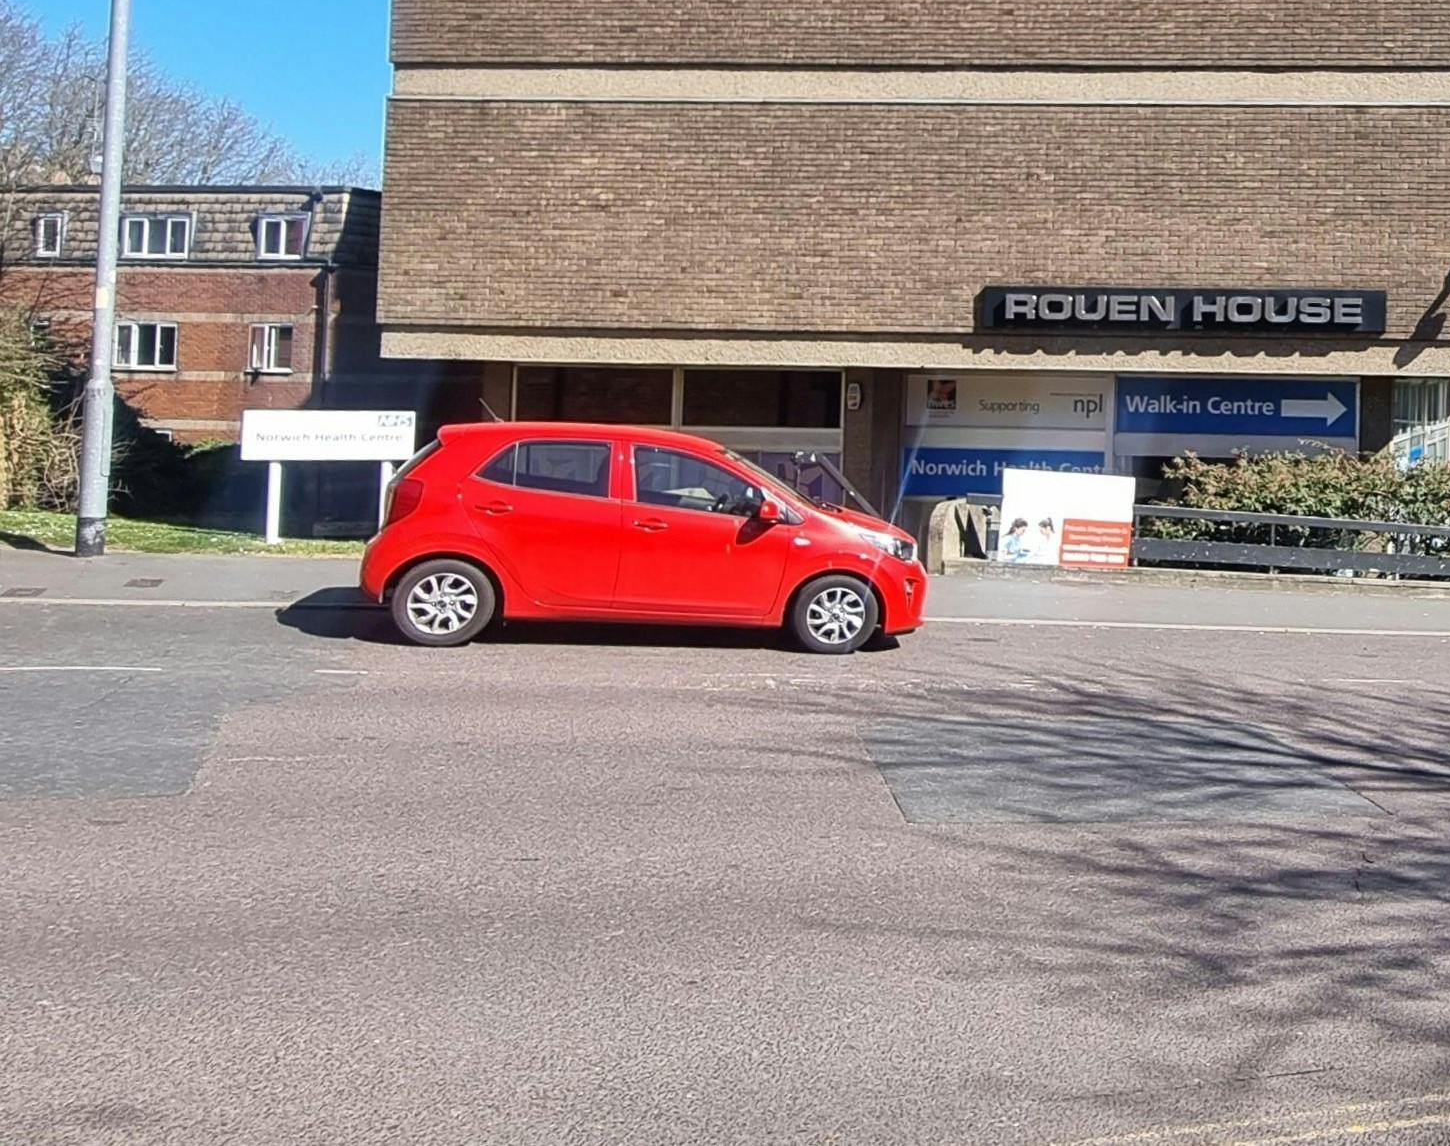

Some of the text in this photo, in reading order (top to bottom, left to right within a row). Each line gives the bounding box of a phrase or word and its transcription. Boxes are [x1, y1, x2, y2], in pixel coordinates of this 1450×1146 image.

[1005, 293, 1363, 324] ROUEN HOUSE
[979, 399, 1040, 414] Supporting
[1073, 394, 1103, 418] npl
[1126, 395, 1275, 415] Walk-in Centre
[256, 432, 403, 442] Norwich Health Centre
[912, 460, 987, 476] Norwich
[994, 460, 1051, 476] Hlth
